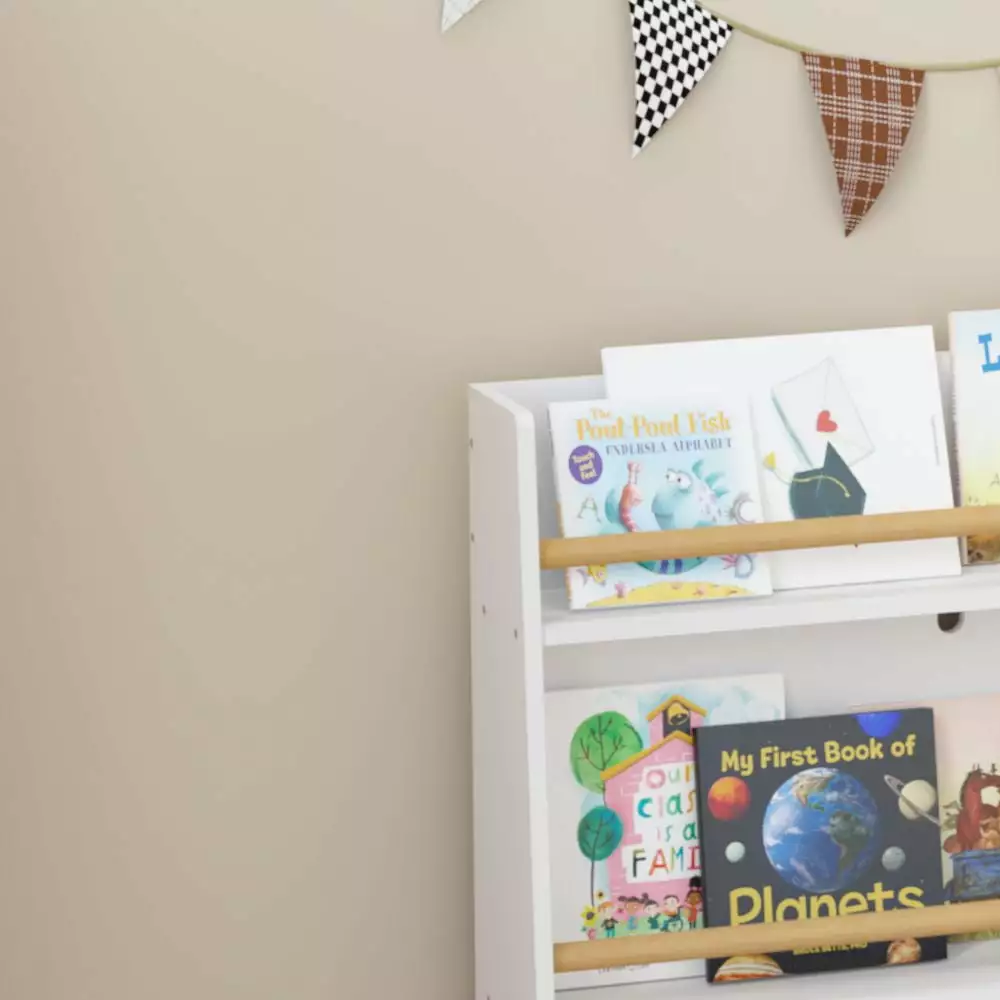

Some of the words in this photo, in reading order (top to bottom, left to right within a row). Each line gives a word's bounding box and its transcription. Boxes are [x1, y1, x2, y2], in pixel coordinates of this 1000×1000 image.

[687, 410, 731, 434] Fish
[720, 750, 754, 777] My
[760, 746, 819, 770] First
[823, 737, 884, 764] Book
[890, 734, 917, 757] of
[729, 882, 925, 926] Planets
